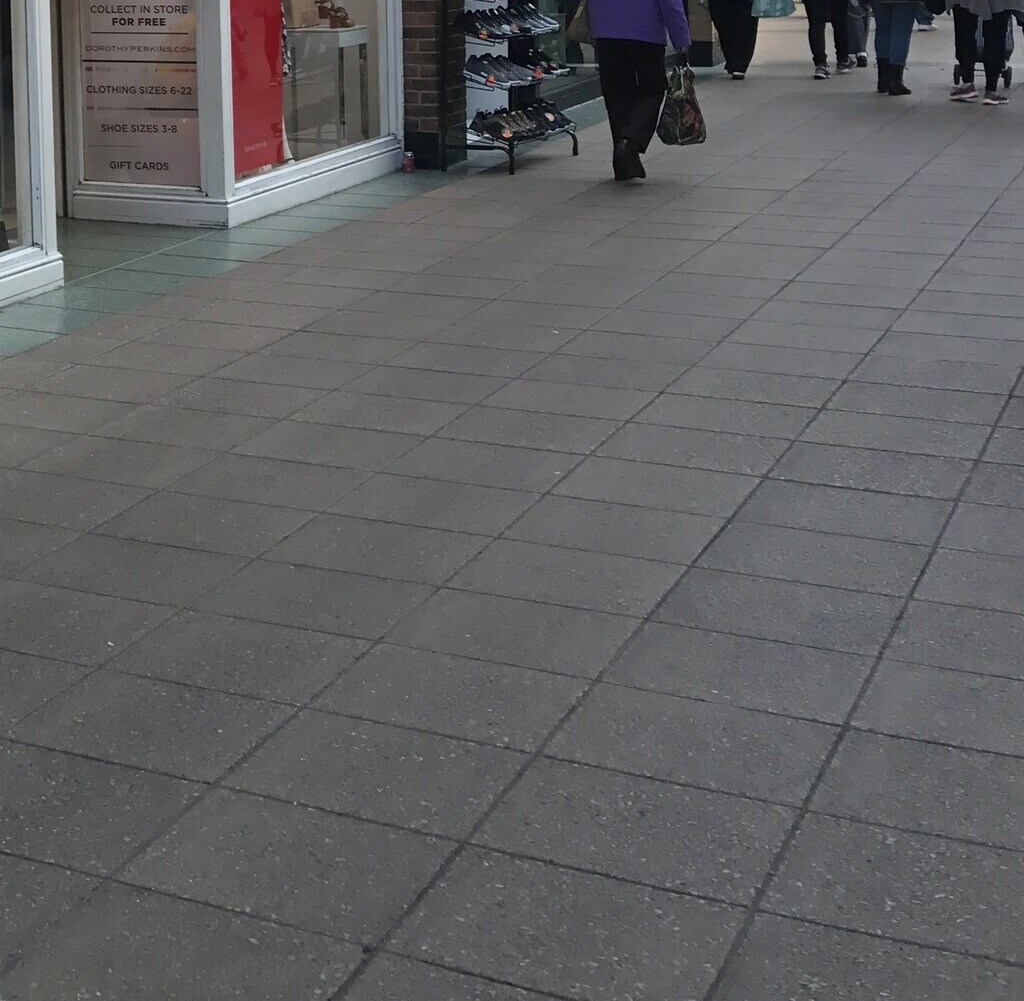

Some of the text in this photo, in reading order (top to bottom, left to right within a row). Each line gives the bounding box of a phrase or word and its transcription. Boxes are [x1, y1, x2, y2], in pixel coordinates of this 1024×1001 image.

[90, 5, 189, 15] COLLECT IN STORE
[112, 17, 167, 27] FOR FREE
[86, 85, 193, 96] CLOTHING SIZES 6-22
[101, 123, 178, 134] SHOE SIZES 3-8
[109, 161, 170, 172] GIFT CARDS
